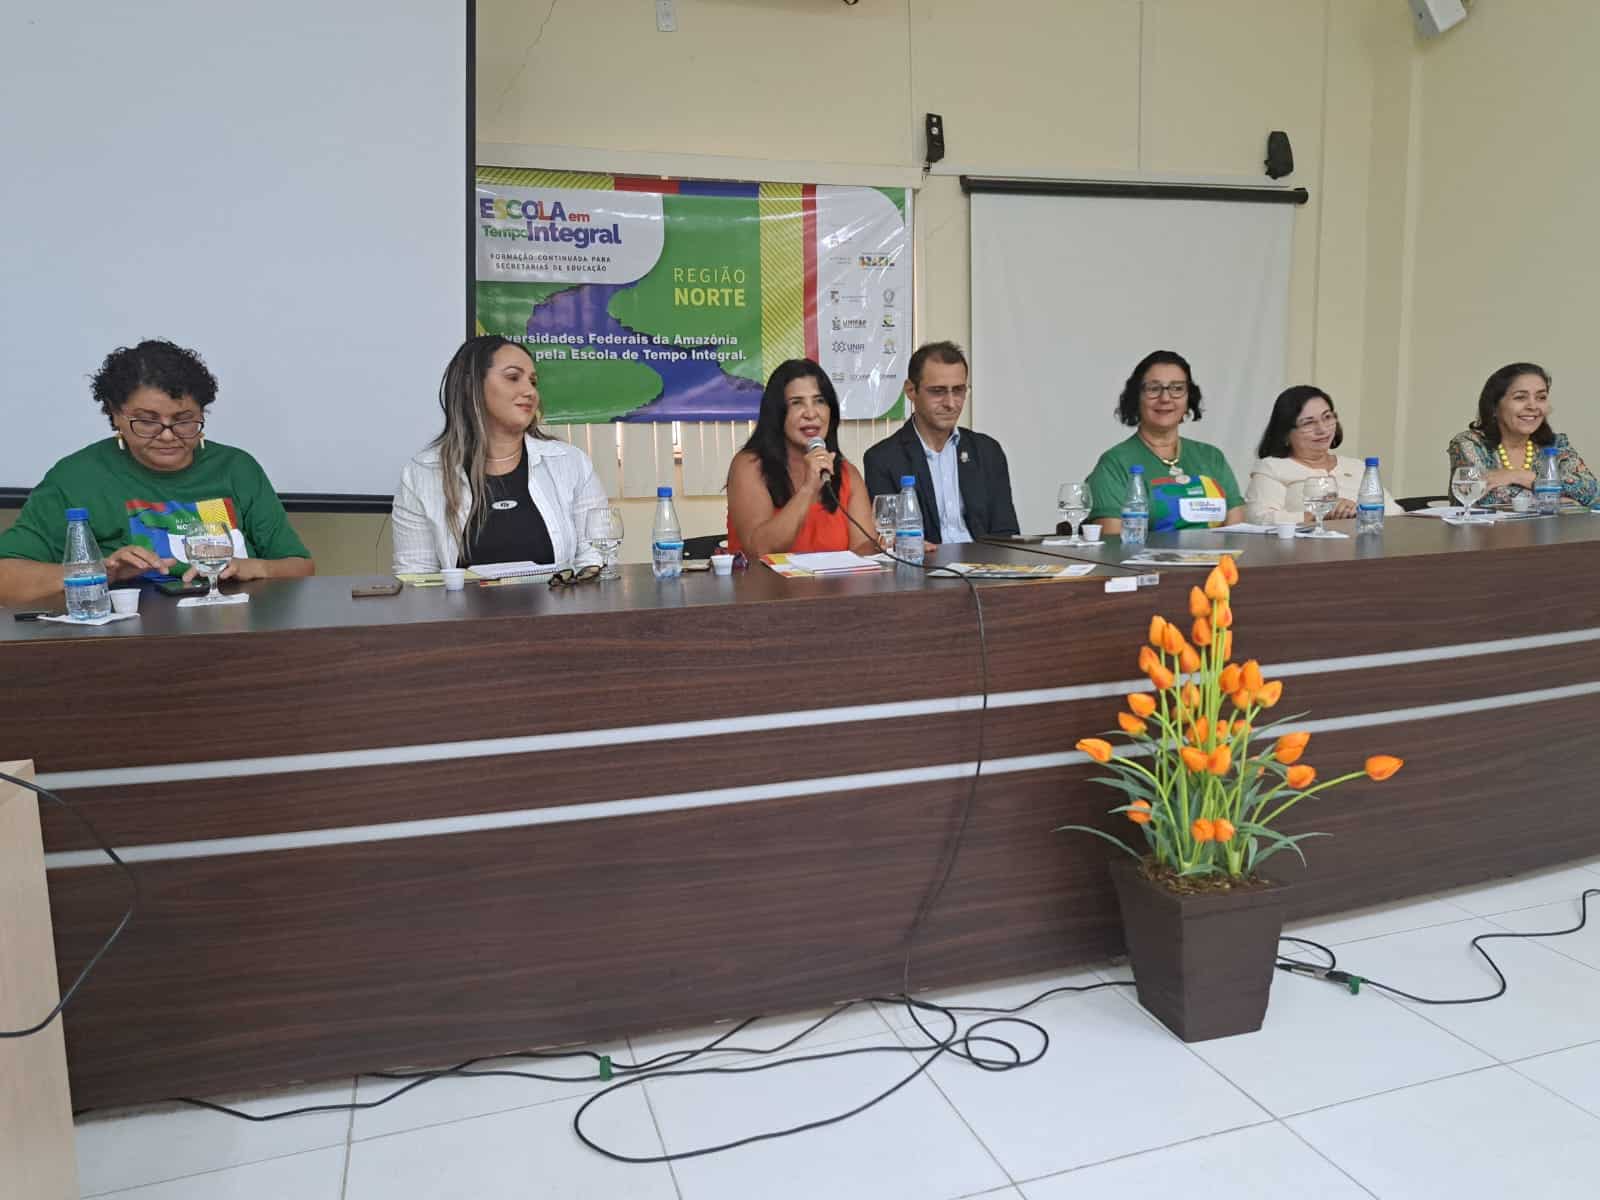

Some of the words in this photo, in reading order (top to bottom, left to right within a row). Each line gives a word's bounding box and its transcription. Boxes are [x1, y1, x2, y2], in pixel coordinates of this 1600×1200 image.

[480, 198, 566, 222] ESCOLA
[568, 212, 590, 222] em
[482, 225, 528, 240] Tempo
[527, 221, 622, 248] Integral
[490, 253, 534, 262] FORMAÇÃO
[537, 254, 588, 263] CONTINUADA
[495, 262, 549, 271] SECRETARIAS
[552, 264, 563, 272] DE
[566, 264, 607, 273] EDUCAÇÃO
[673, 266, 745, 284] REGIÃO
[674, 287, 746, 307] NORTE
[480, 332, 584, 345] versidades
[588, 333, 648, 345] Federais
[652, 334, 669, 345] da
[674, 334, 737, 345] Amazônia
[535, 349, 566, 362] pela
[571, 349, 617, 360] Escola
[622, 349, 639, 360] de
[643, 349, 687, 362] Tempo
[692, 350, 746, 362] Integral.
